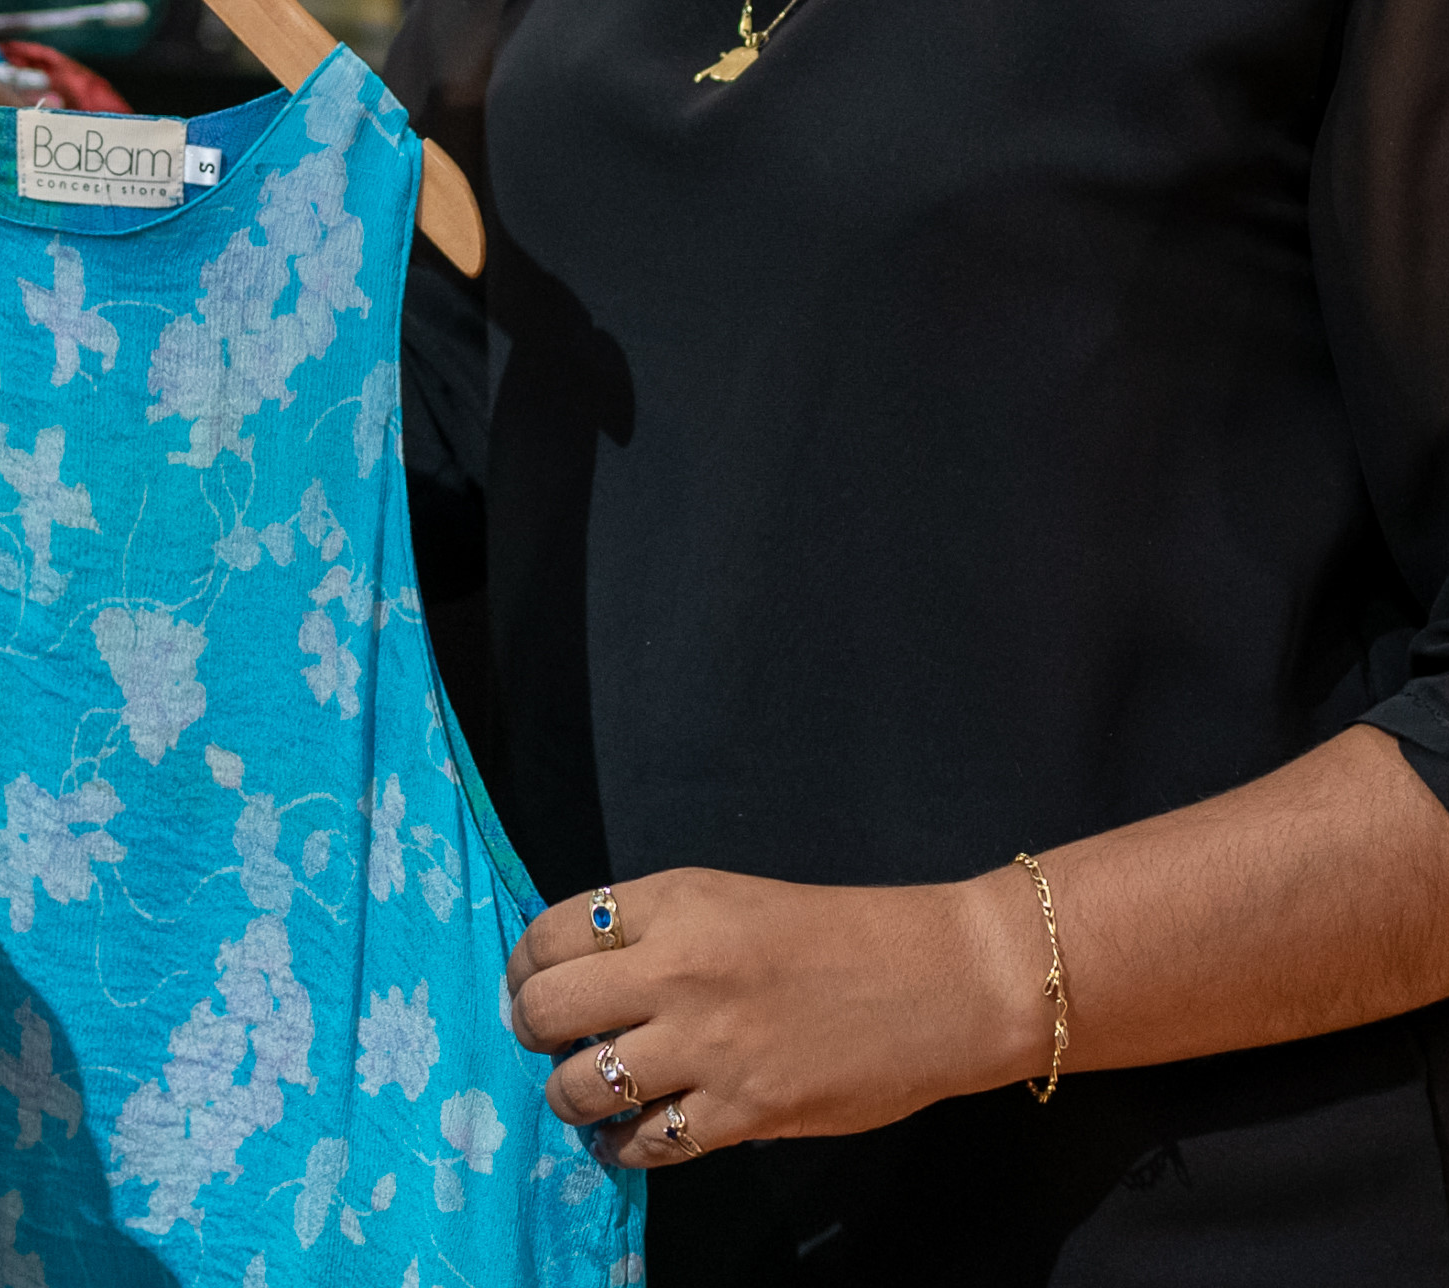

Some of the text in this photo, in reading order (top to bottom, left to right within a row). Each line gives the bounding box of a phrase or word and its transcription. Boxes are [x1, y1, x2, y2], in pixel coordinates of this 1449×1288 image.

[33, 125, 172, 177] BaBam
[199, 161, 215, 174] S
[36, 178, 167, 197] concept store
